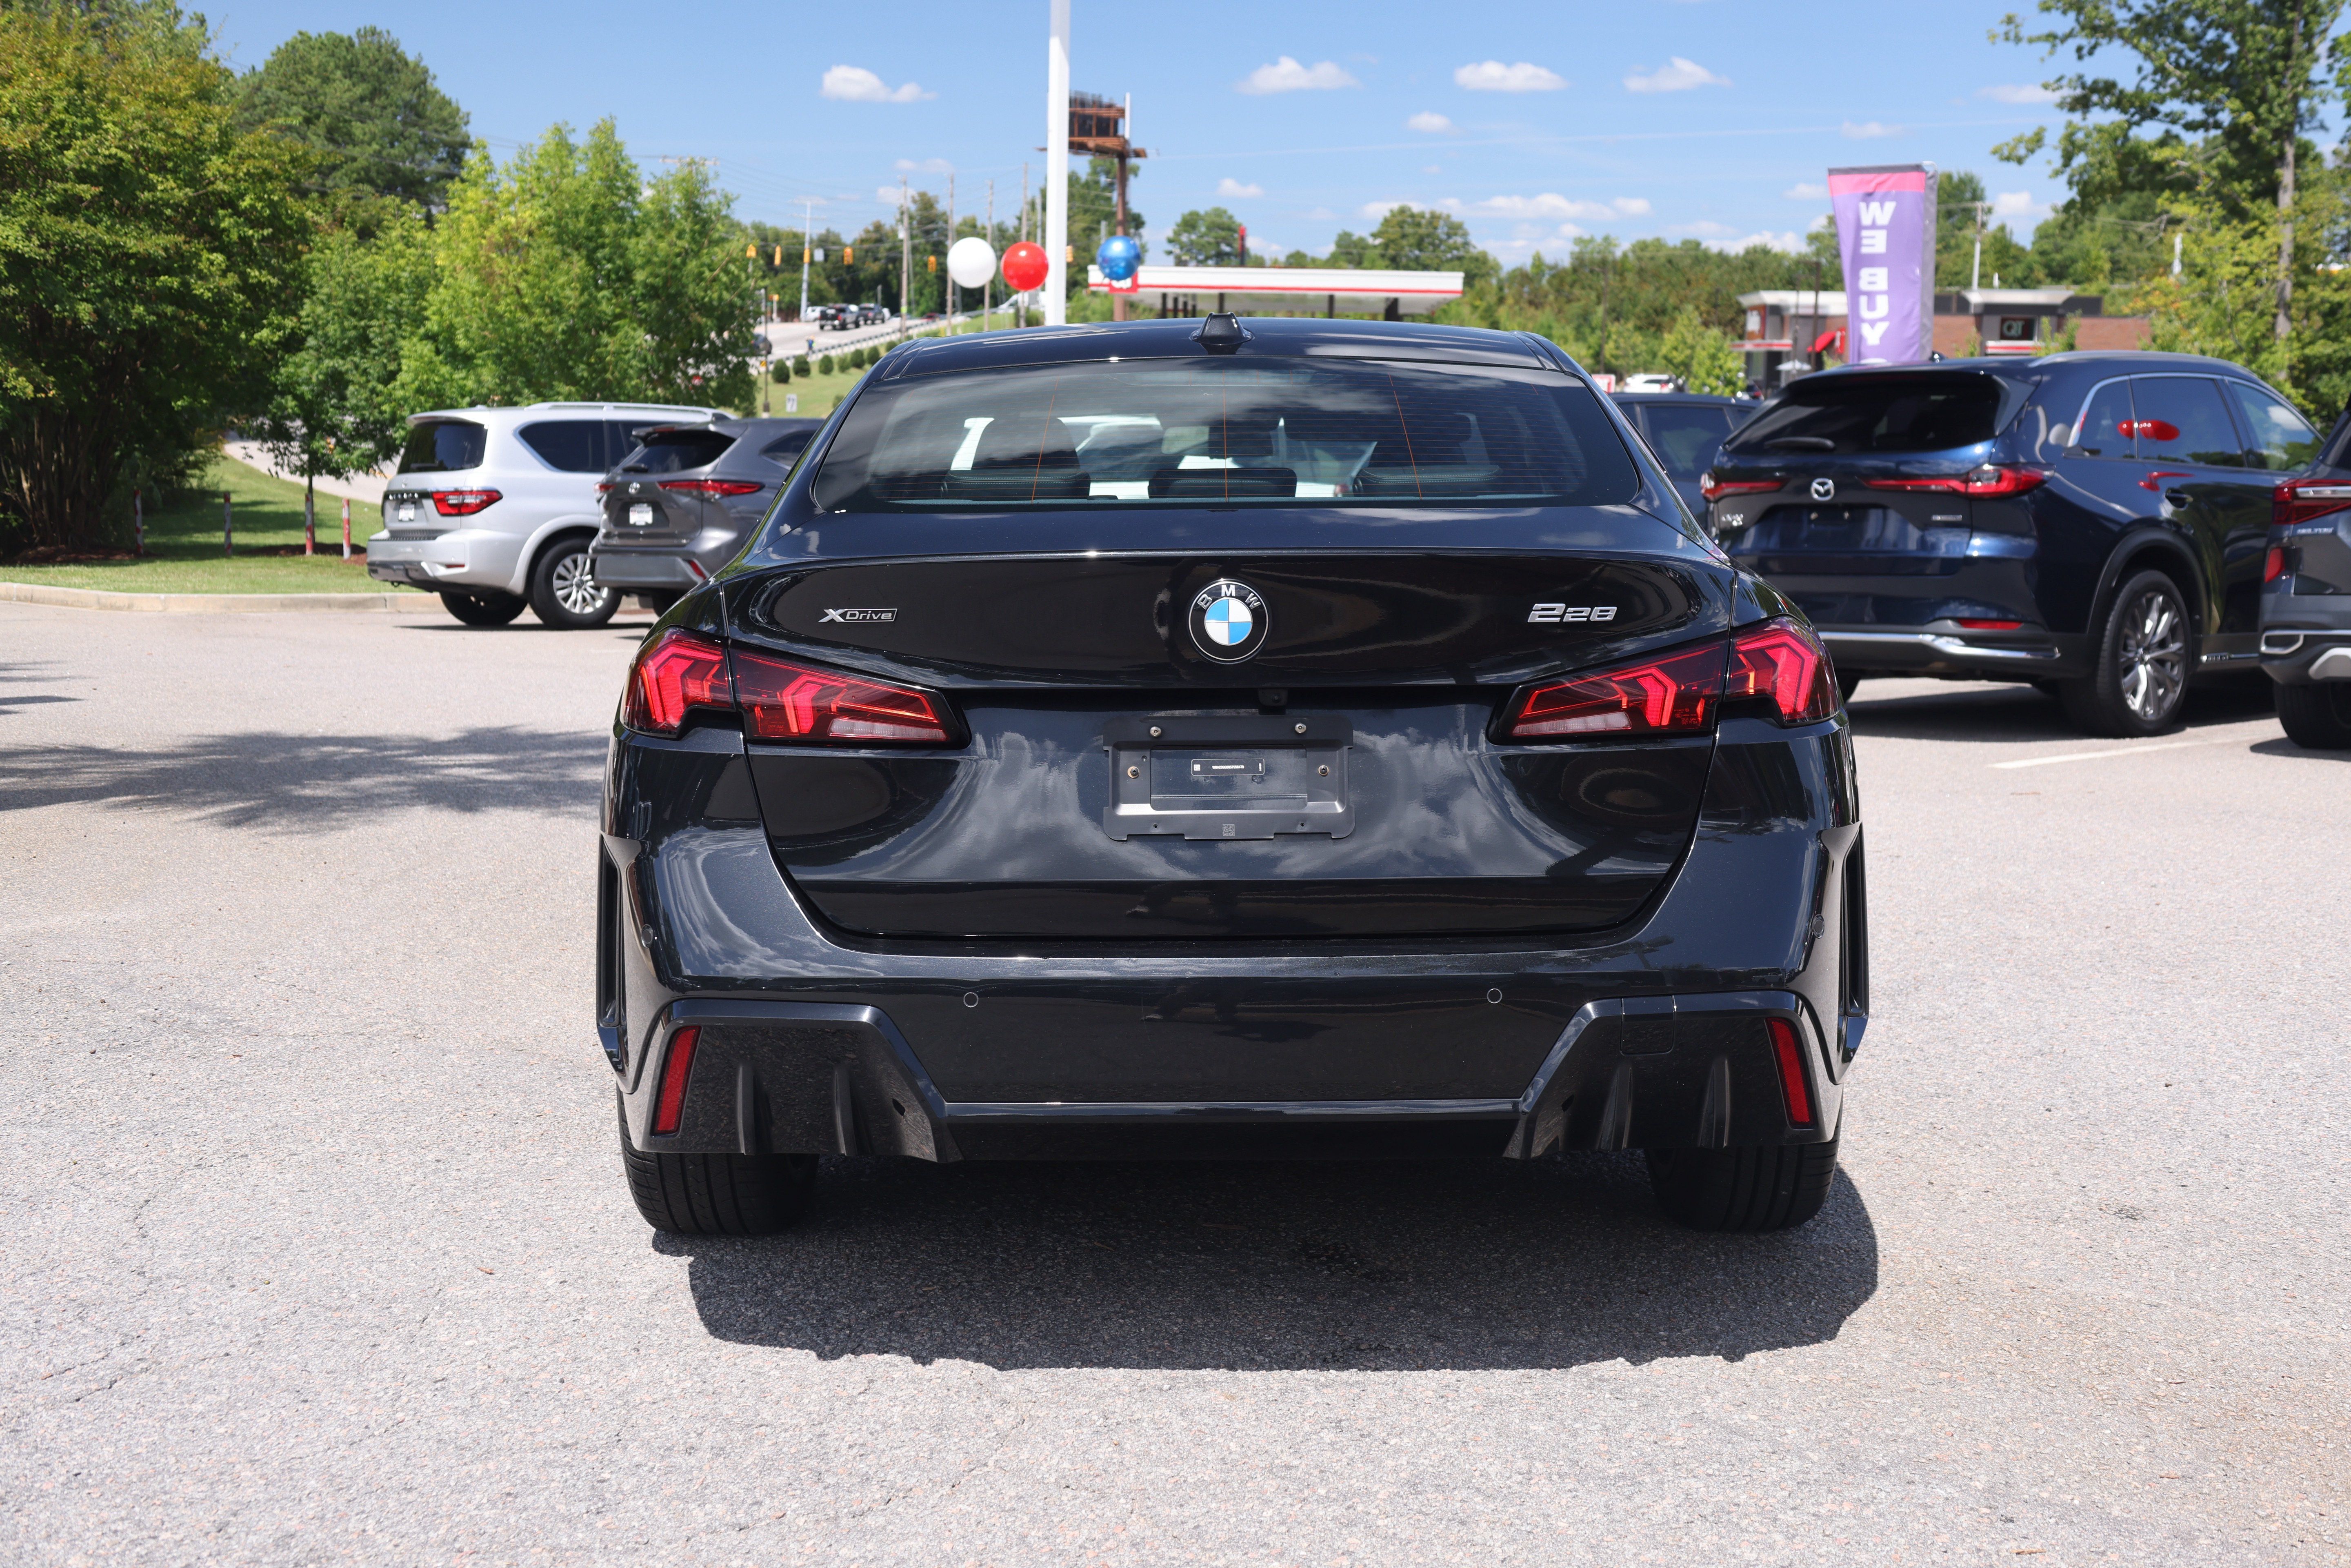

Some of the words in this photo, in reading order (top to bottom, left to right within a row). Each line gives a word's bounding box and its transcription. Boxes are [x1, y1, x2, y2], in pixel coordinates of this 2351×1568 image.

[2003, 320, 2025, 336] QT
[1197, 584, 1261, 610] BMW
[1527, 603, 1617, 622] 228
